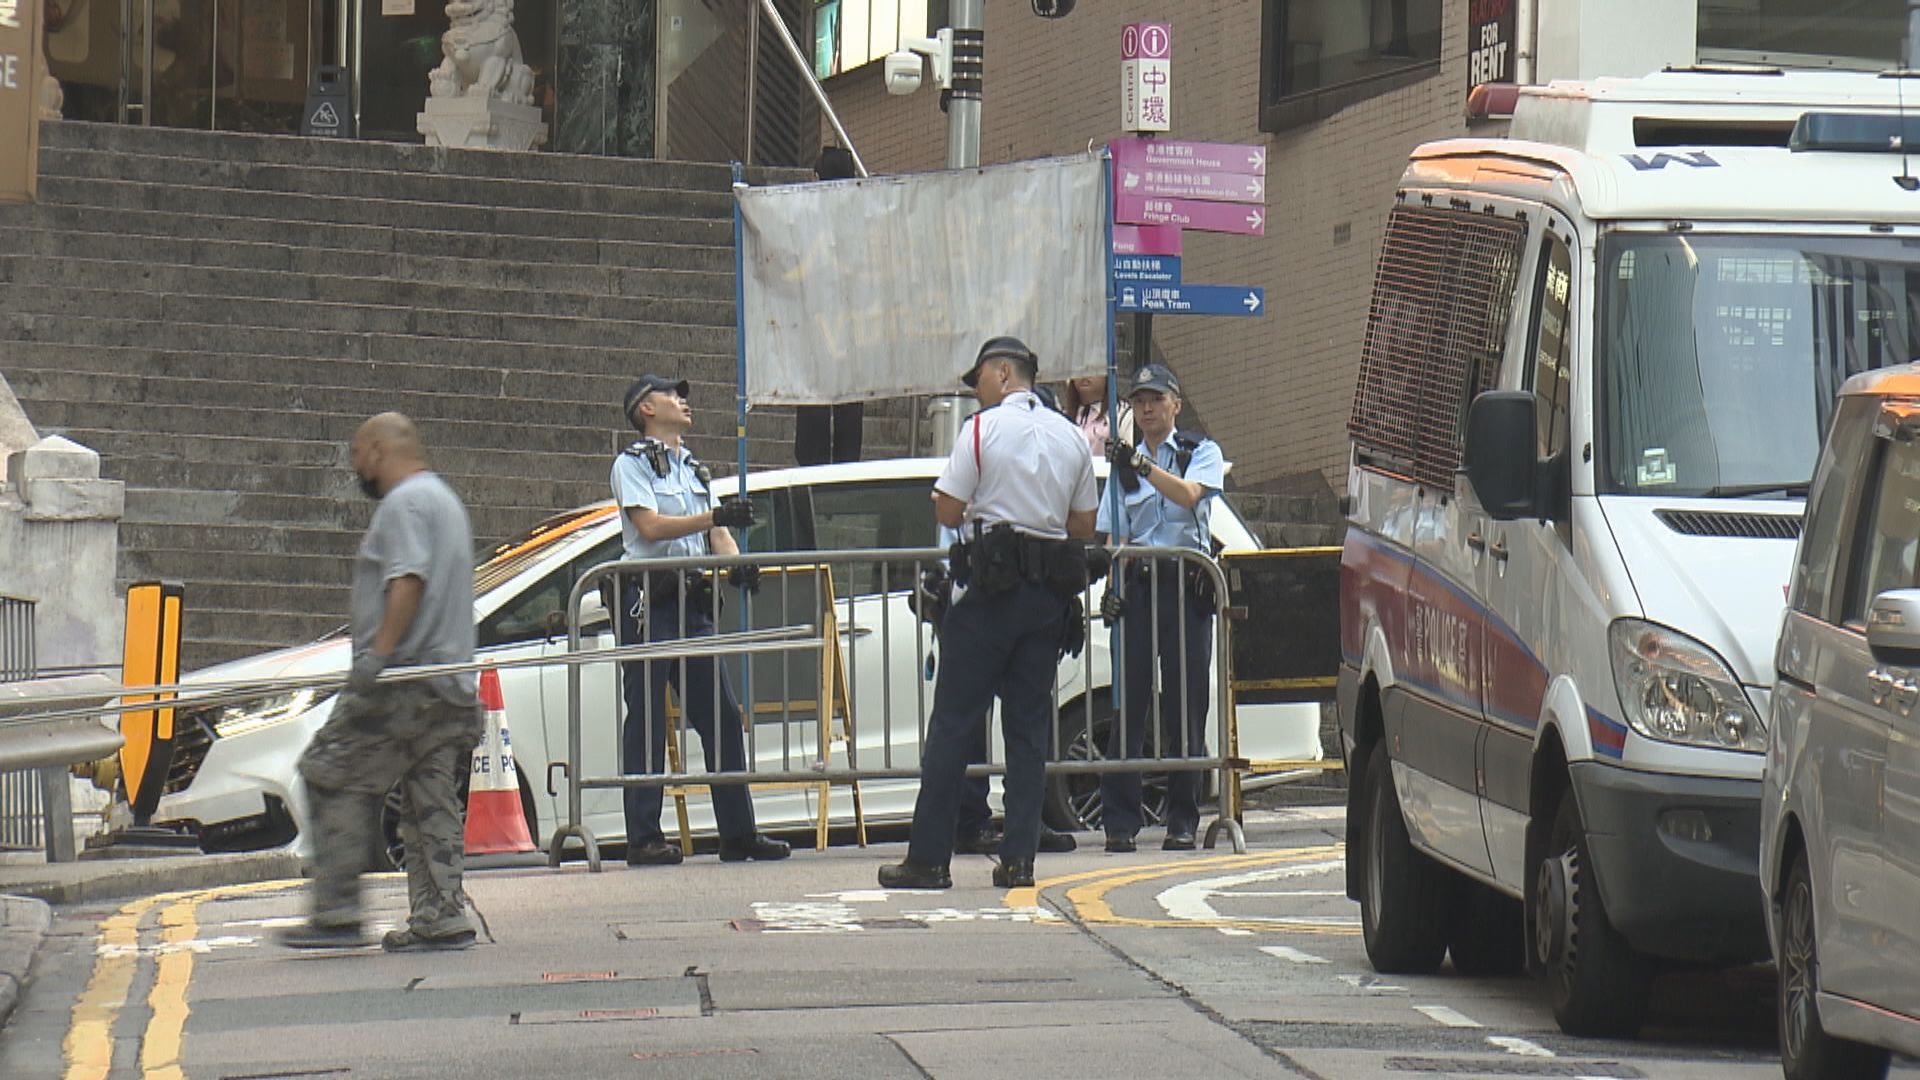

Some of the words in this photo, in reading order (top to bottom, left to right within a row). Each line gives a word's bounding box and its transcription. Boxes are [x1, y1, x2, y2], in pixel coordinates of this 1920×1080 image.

[1481, 22, 1498, 47] FOR
[1471, 41, 1507, 87] RENT
[1126, 65, 1134, 123] Central
[1142, 65, 1167, 124] 中環
[1146, 156, 1194, 167] Government
[1196, 158, 1221, 168] House
[1143, 211, 1170, 223] Fringe
[1170, 213, 1190, 224] Club
[1139, 271, 1173, 281] Escalator
[1142, 299, 1165, 310] Peak
[1166, 300, 1191, 310] Tram
[1424, 605, 1458, 668] POLICE
